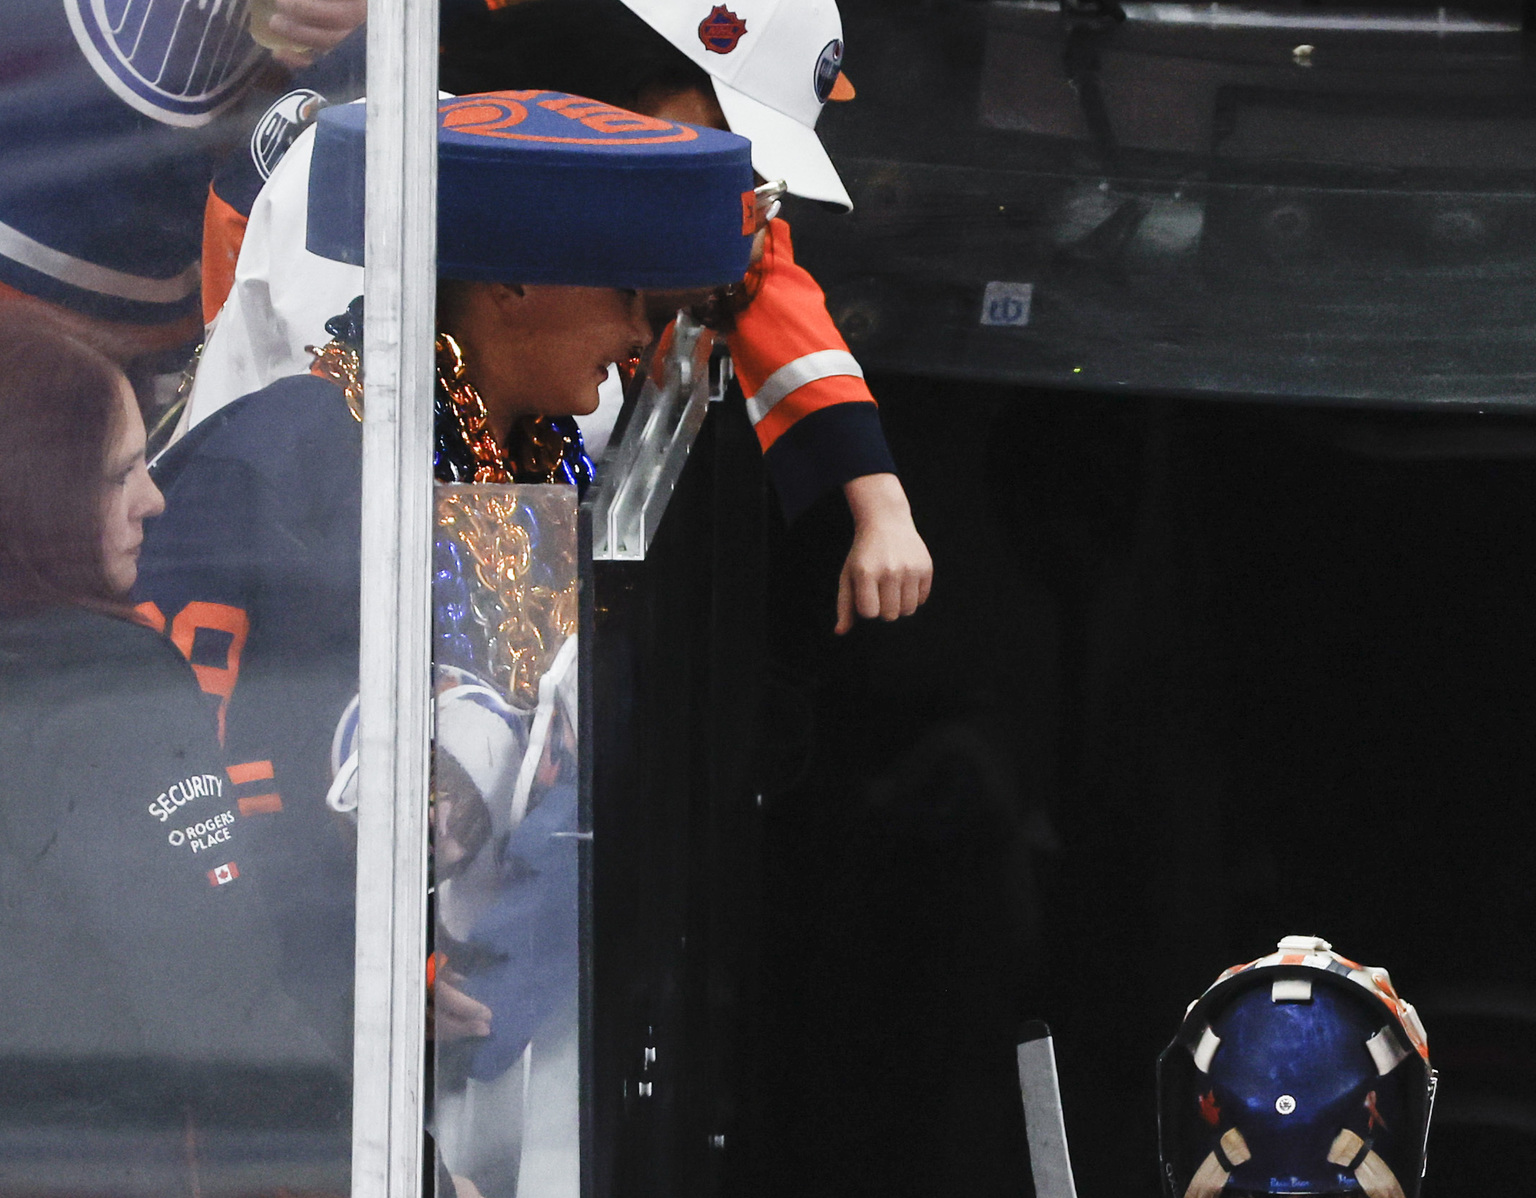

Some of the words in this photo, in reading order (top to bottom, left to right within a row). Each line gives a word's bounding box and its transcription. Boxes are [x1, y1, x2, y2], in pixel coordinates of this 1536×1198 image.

[148, 774, 223, 822] SECURITY
[185, 811, 235, 839] ROGERS
[190, 828, 232, 853] PLACE
